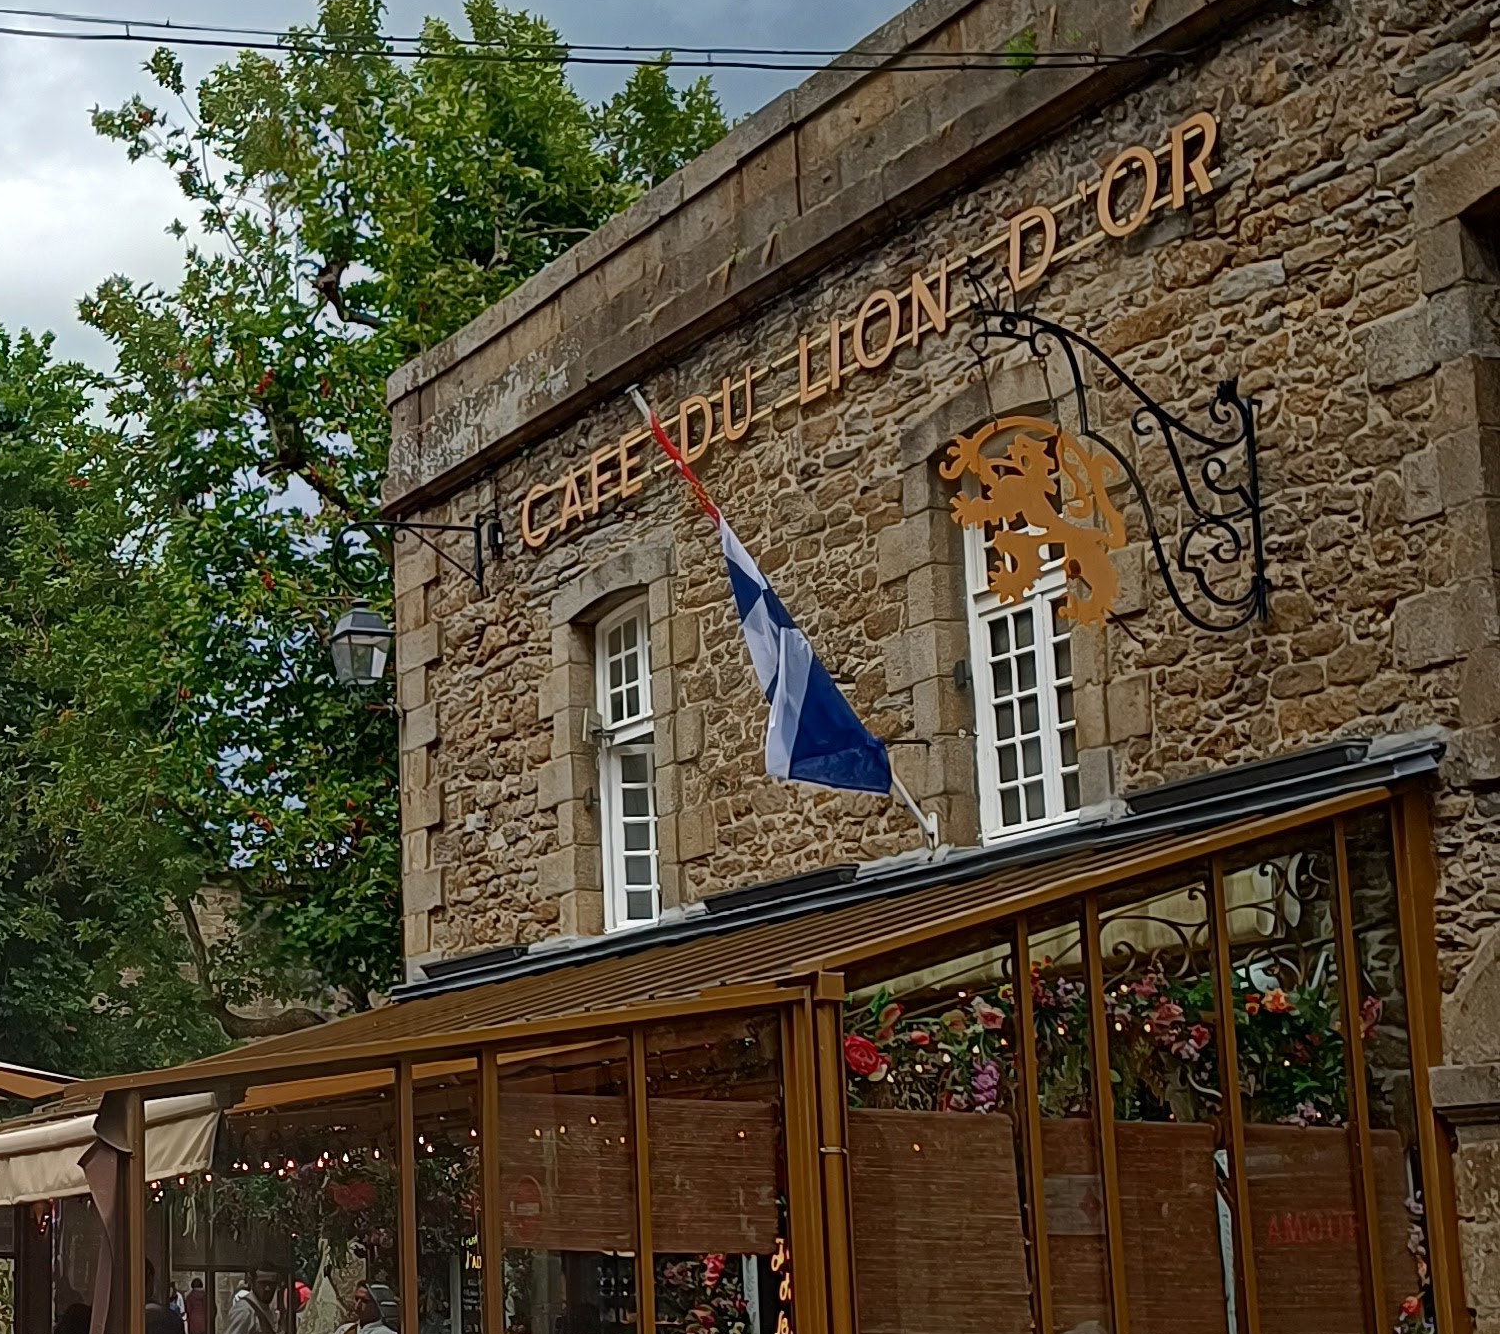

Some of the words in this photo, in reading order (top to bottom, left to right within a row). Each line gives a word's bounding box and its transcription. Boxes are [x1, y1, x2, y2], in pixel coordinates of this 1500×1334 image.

[520, 430, 642, 549] CAFE
[679, 364, 754, 463] DU
[798, 256, 949, 405] LION
[1007, 110, 1221, 292] D'OR
